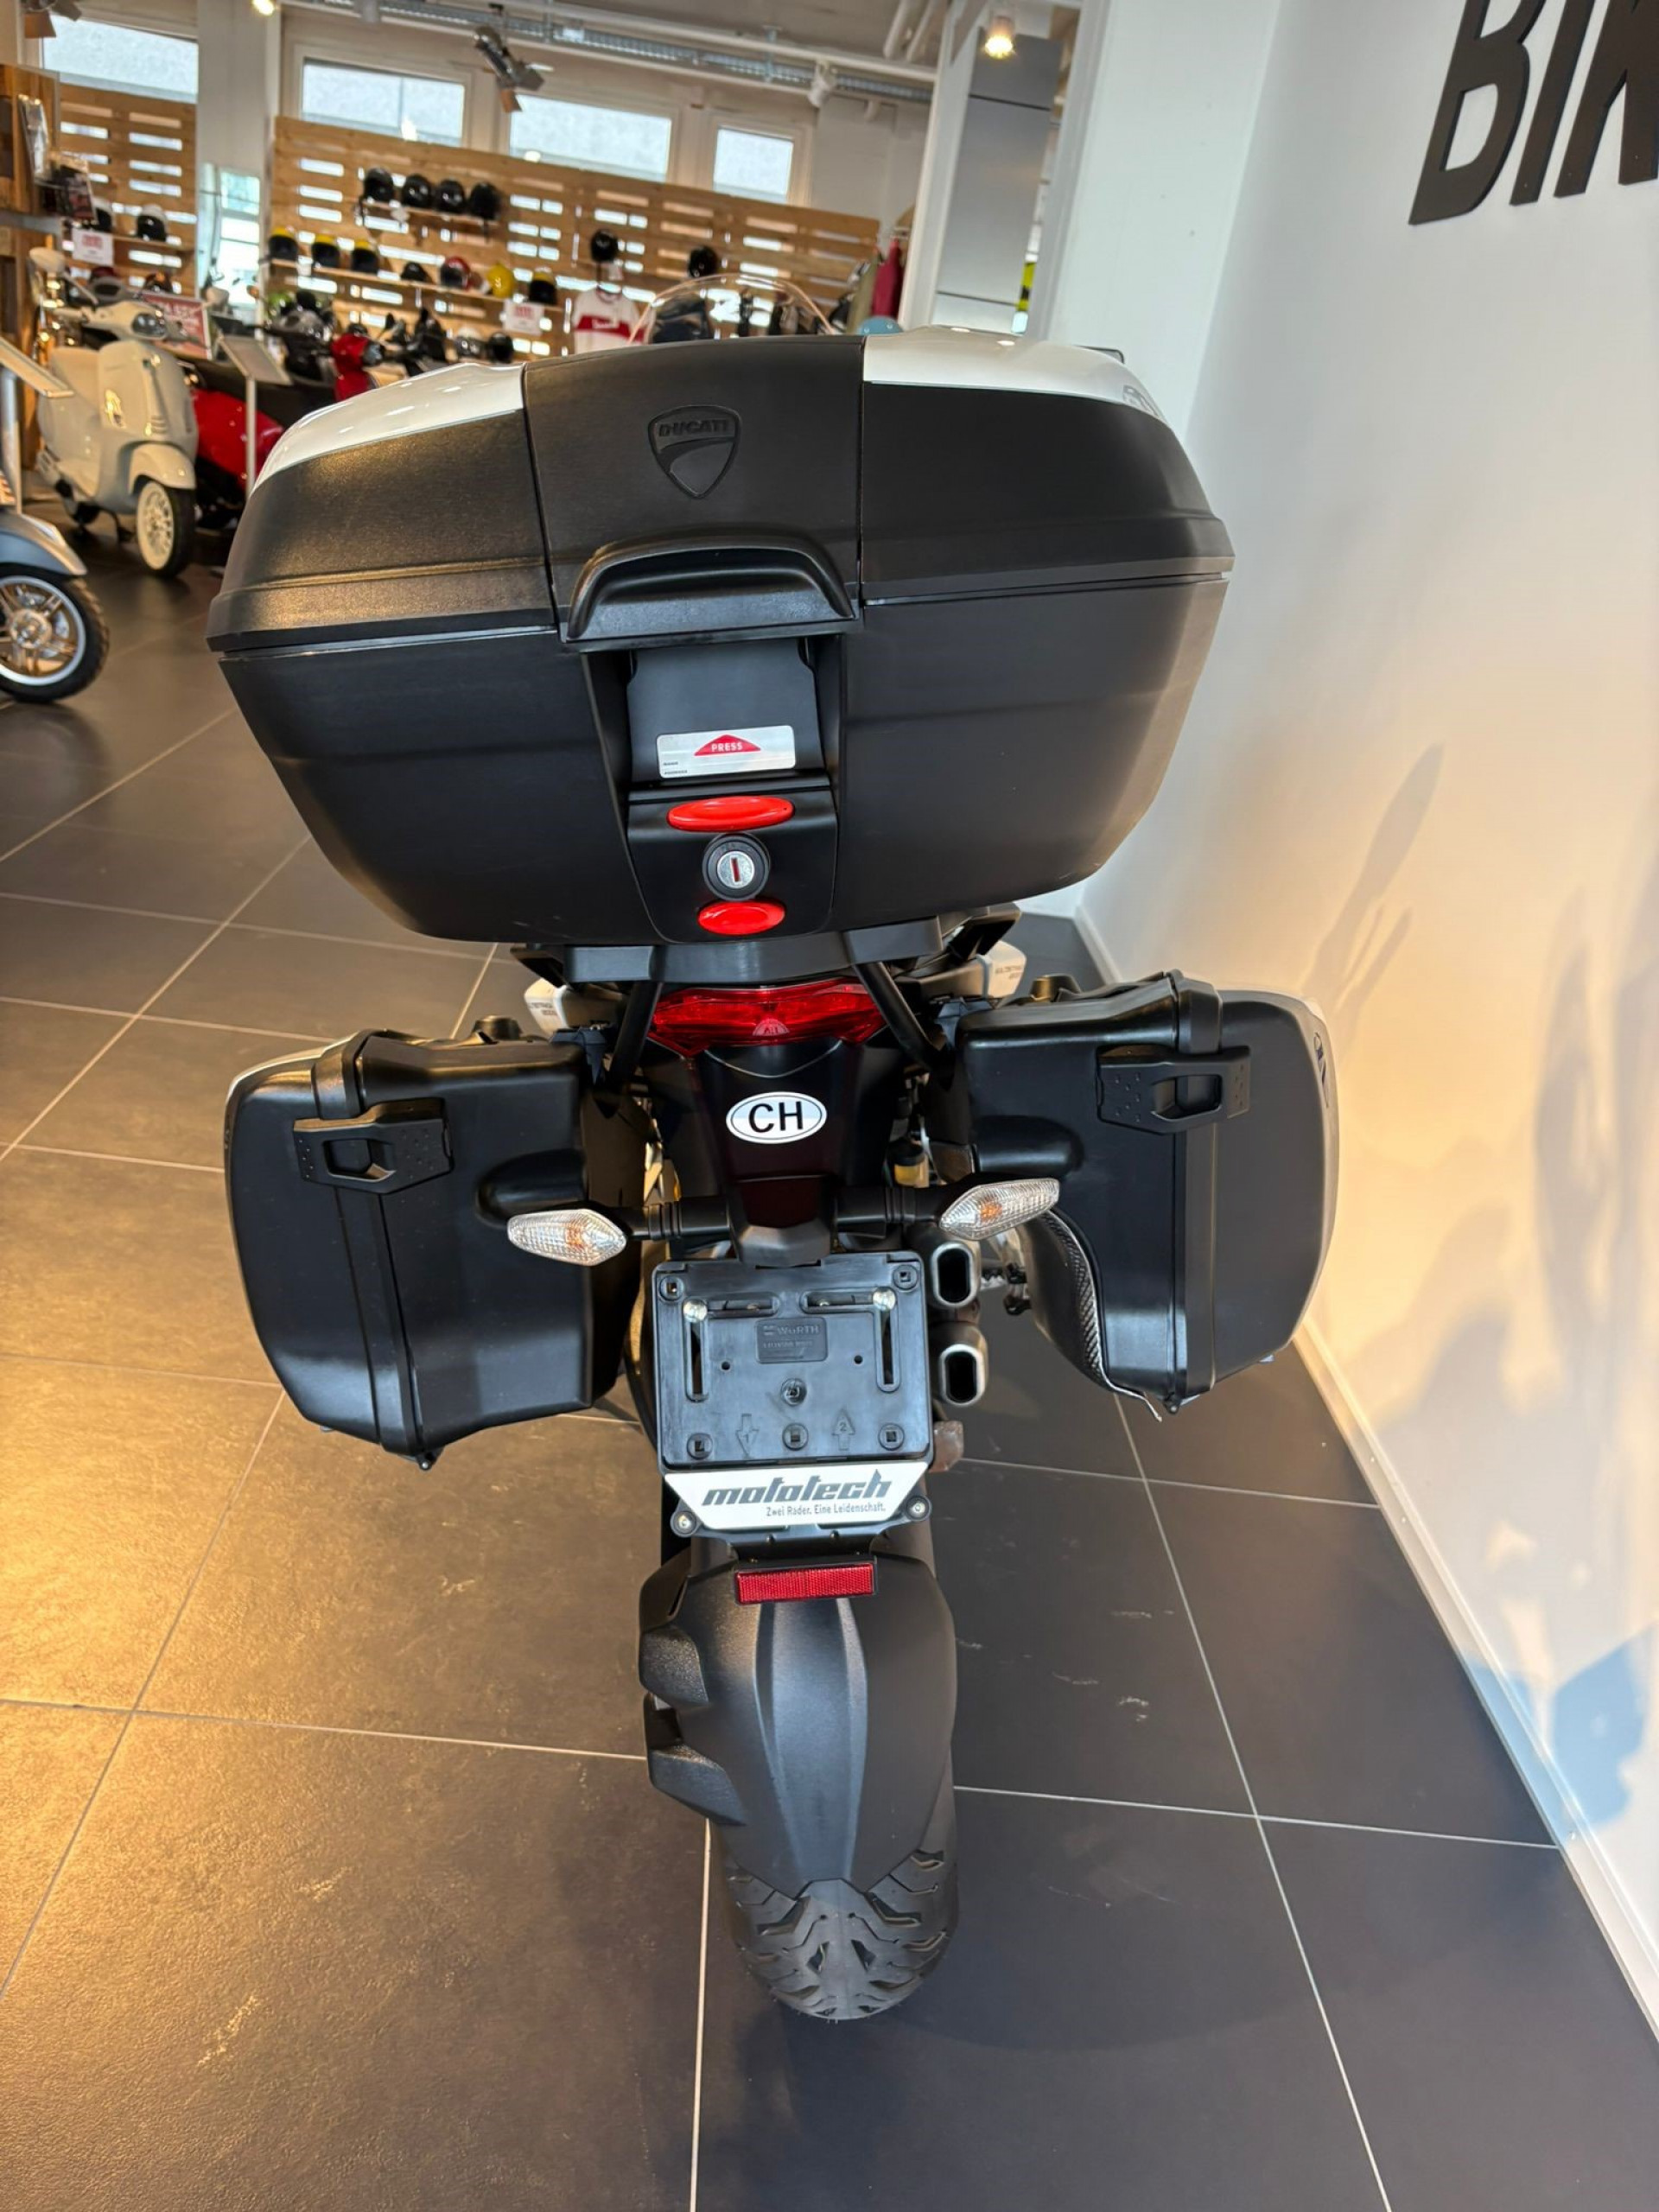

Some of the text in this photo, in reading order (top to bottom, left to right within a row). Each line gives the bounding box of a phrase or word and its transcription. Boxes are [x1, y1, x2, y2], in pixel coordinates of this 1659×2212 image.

[658, 419, 729, 437] DUCATI
[711, 741, 743, 753] PRESS
[748, 1101, 804, 1134] CH
[702, 1469, 893, 1506] mototech
[766, 1505, 785, 1517] Zwei
[815, 1503, 831, 1515] Eine
[834, 1502, 887, 1514] Leidenschaft.
